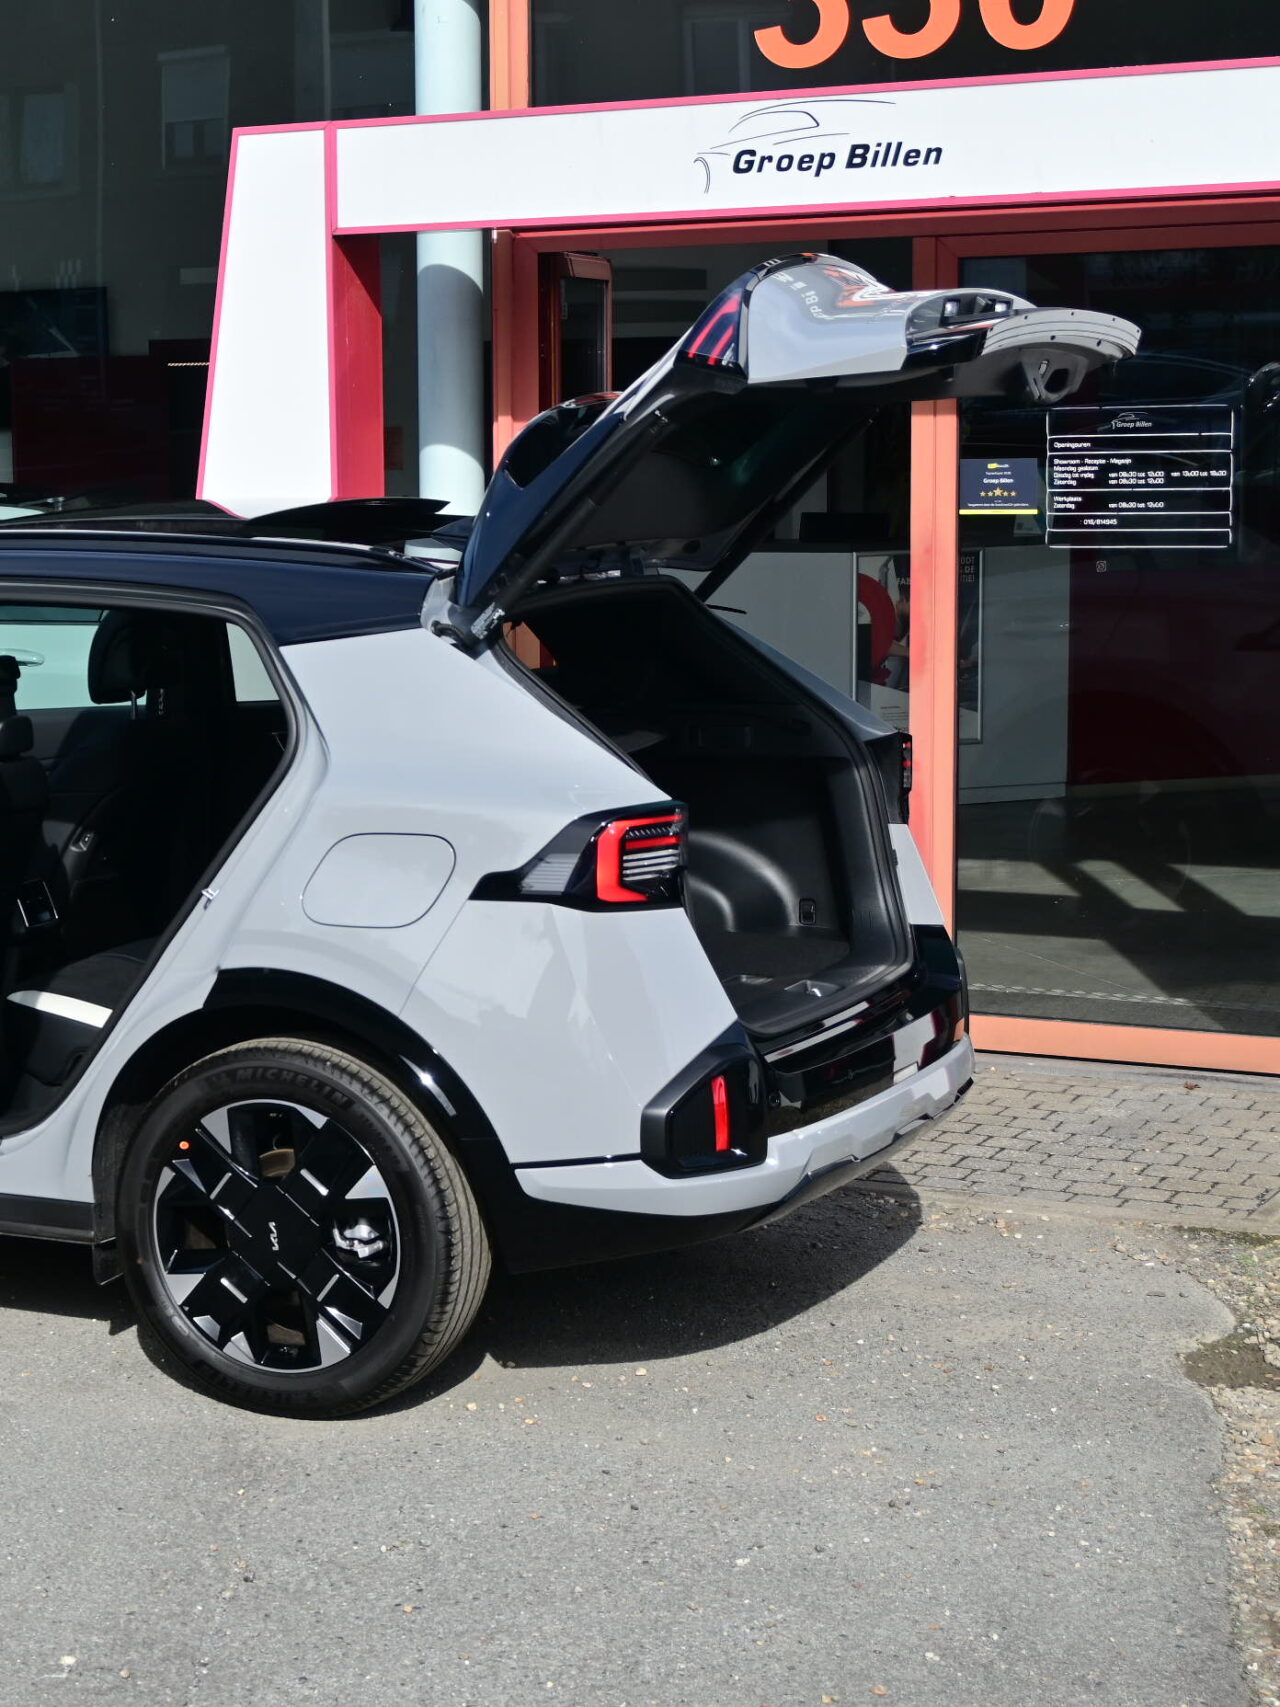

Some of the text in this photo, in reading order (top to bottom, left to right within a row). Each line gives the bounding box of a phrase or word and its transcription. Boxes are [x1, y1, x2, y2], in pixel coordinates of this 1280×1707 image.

[732, 141, 943, 177] Groep Billen
[1116, 421, 1134, 429] Groep
[236, 1067, 352, 1107] MICHELIN
